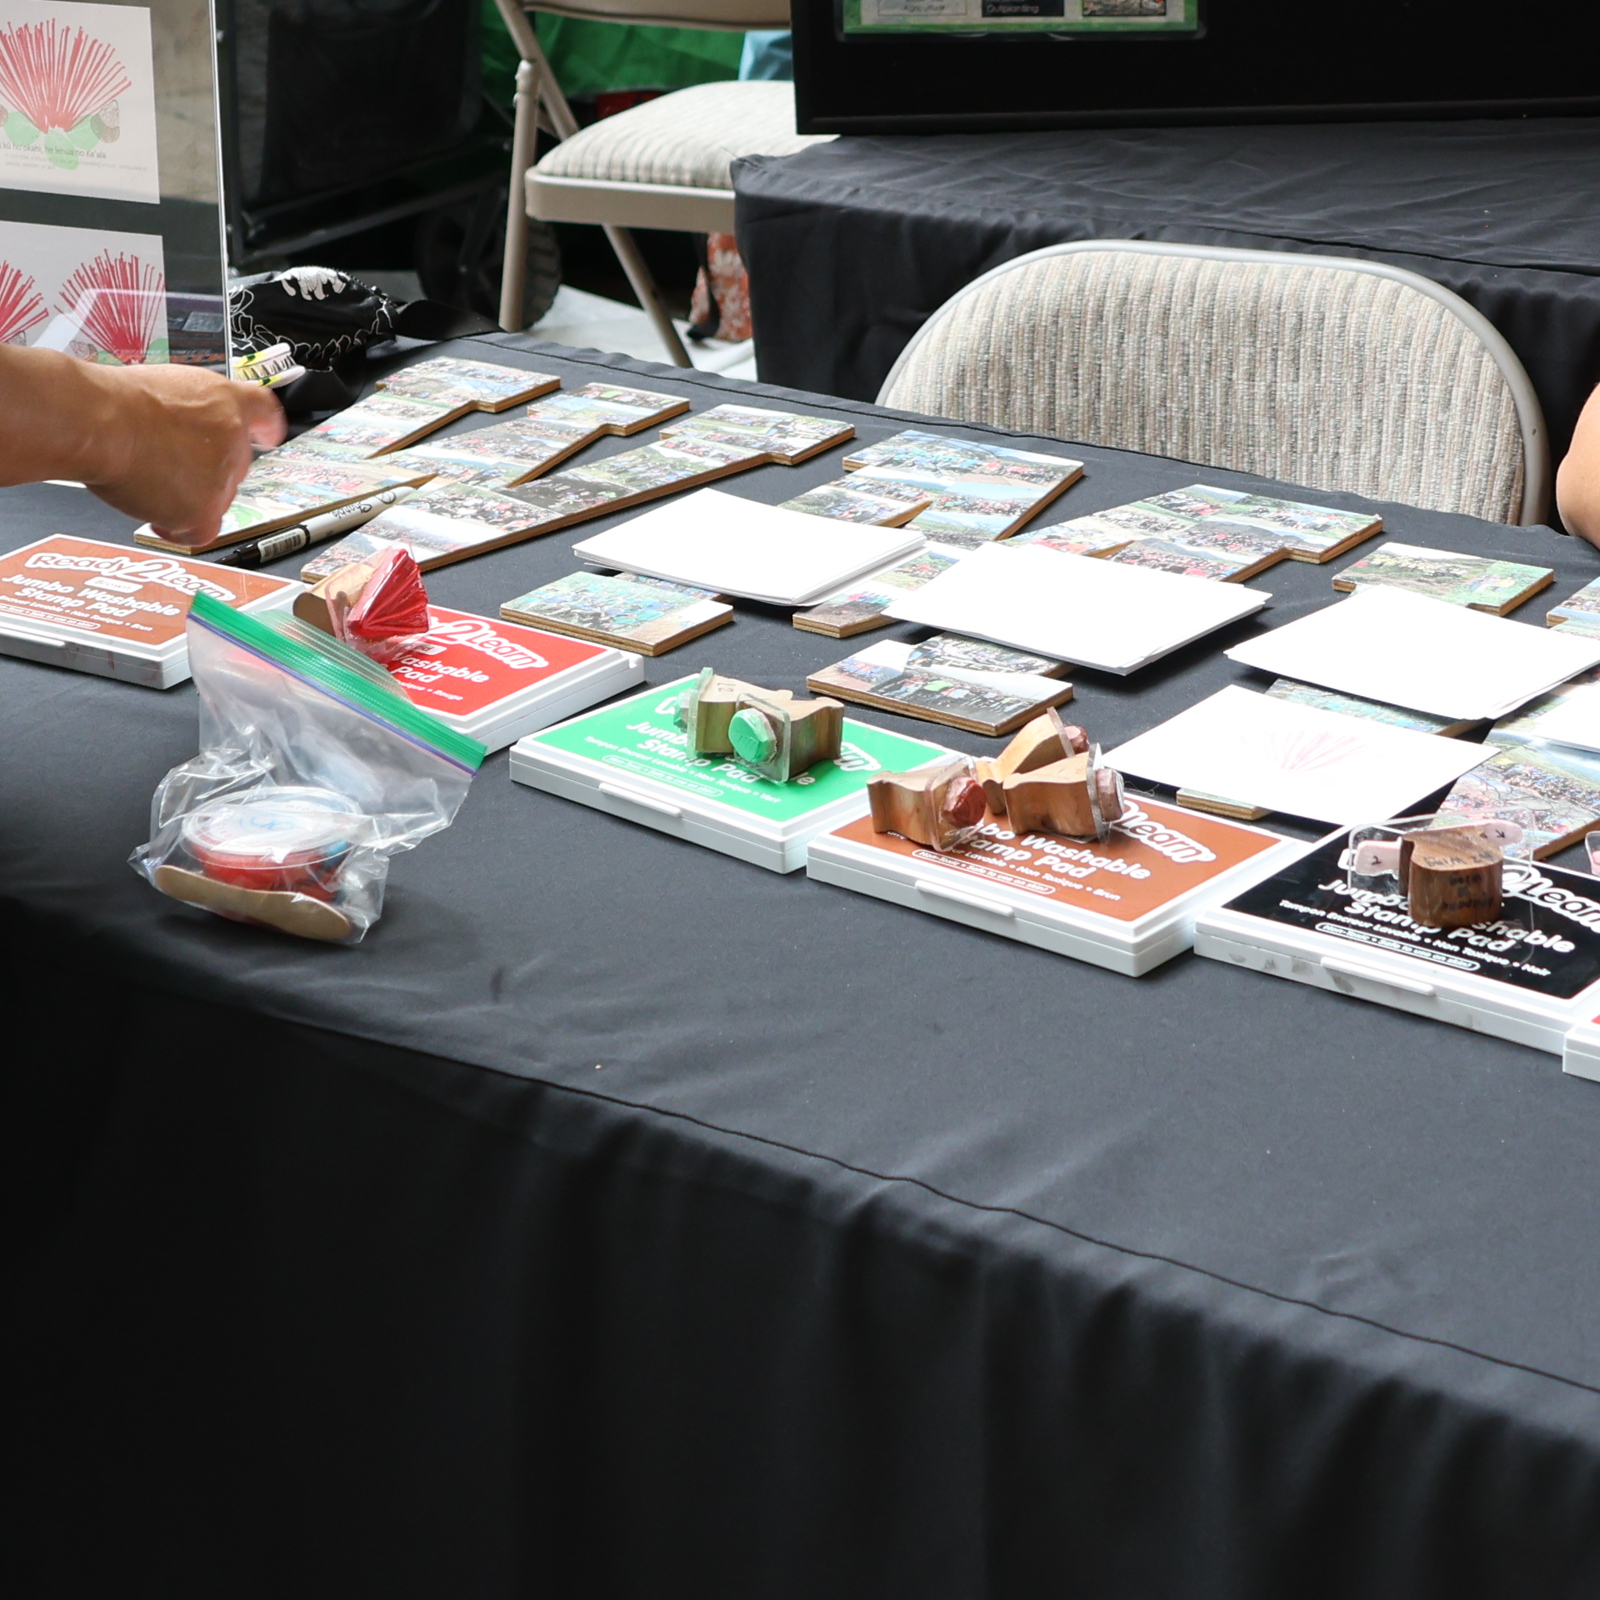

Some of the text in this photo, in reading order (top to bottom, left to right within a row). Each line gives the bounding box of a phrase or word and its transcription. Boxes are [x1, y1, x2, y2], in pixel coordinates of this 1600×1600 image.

[2, 574, 74, 594] Jumbo
[77, 586, 181, 617] Washable
[14, 586, 85, 609] Stamp
[85, 597, 136, 618] Pad
[393, 665, 444, 685] Pad
[712, 760, 759, 784] Pad
[1021, 833, 1152, 881] Washable
[1034, 855, 1096, 880] Pad
[965, 849, 1121, 901] Lavable Non Toxique Brun
[1279, 899, 1551, 977] Tampon Encreur Lavable Non Toxique Noir
[1448, 927, 1516, 953] Pad
